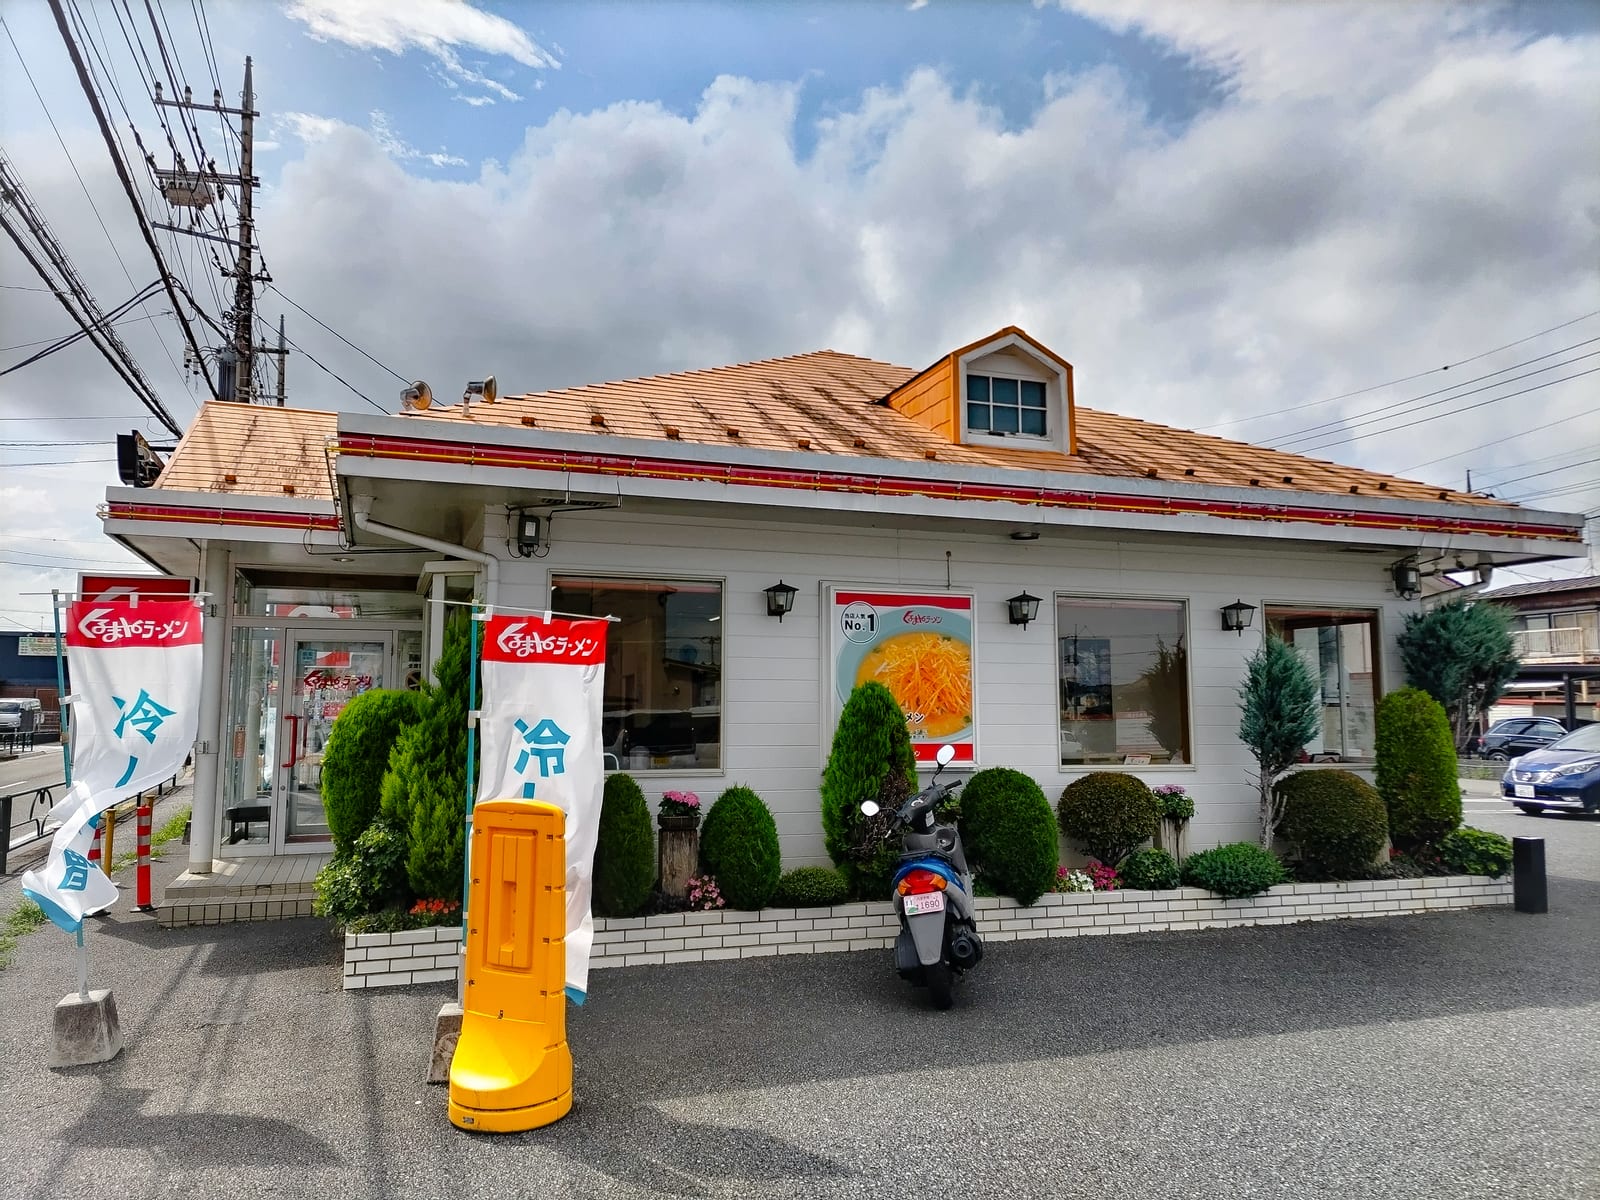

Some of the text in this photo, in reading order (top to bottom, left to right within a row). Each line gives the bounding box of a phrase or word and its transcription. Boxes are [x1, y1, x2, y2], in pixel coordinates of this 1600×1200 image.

[78, 608, 189, 643] くるまやラーメン
[845, 614, 875, 631] No.1
[903, 610, 943, 626] くるまやラーメン
[496, 622, 599, 657] くるまやラーメン
[920, 899, 940, 909] 1690
